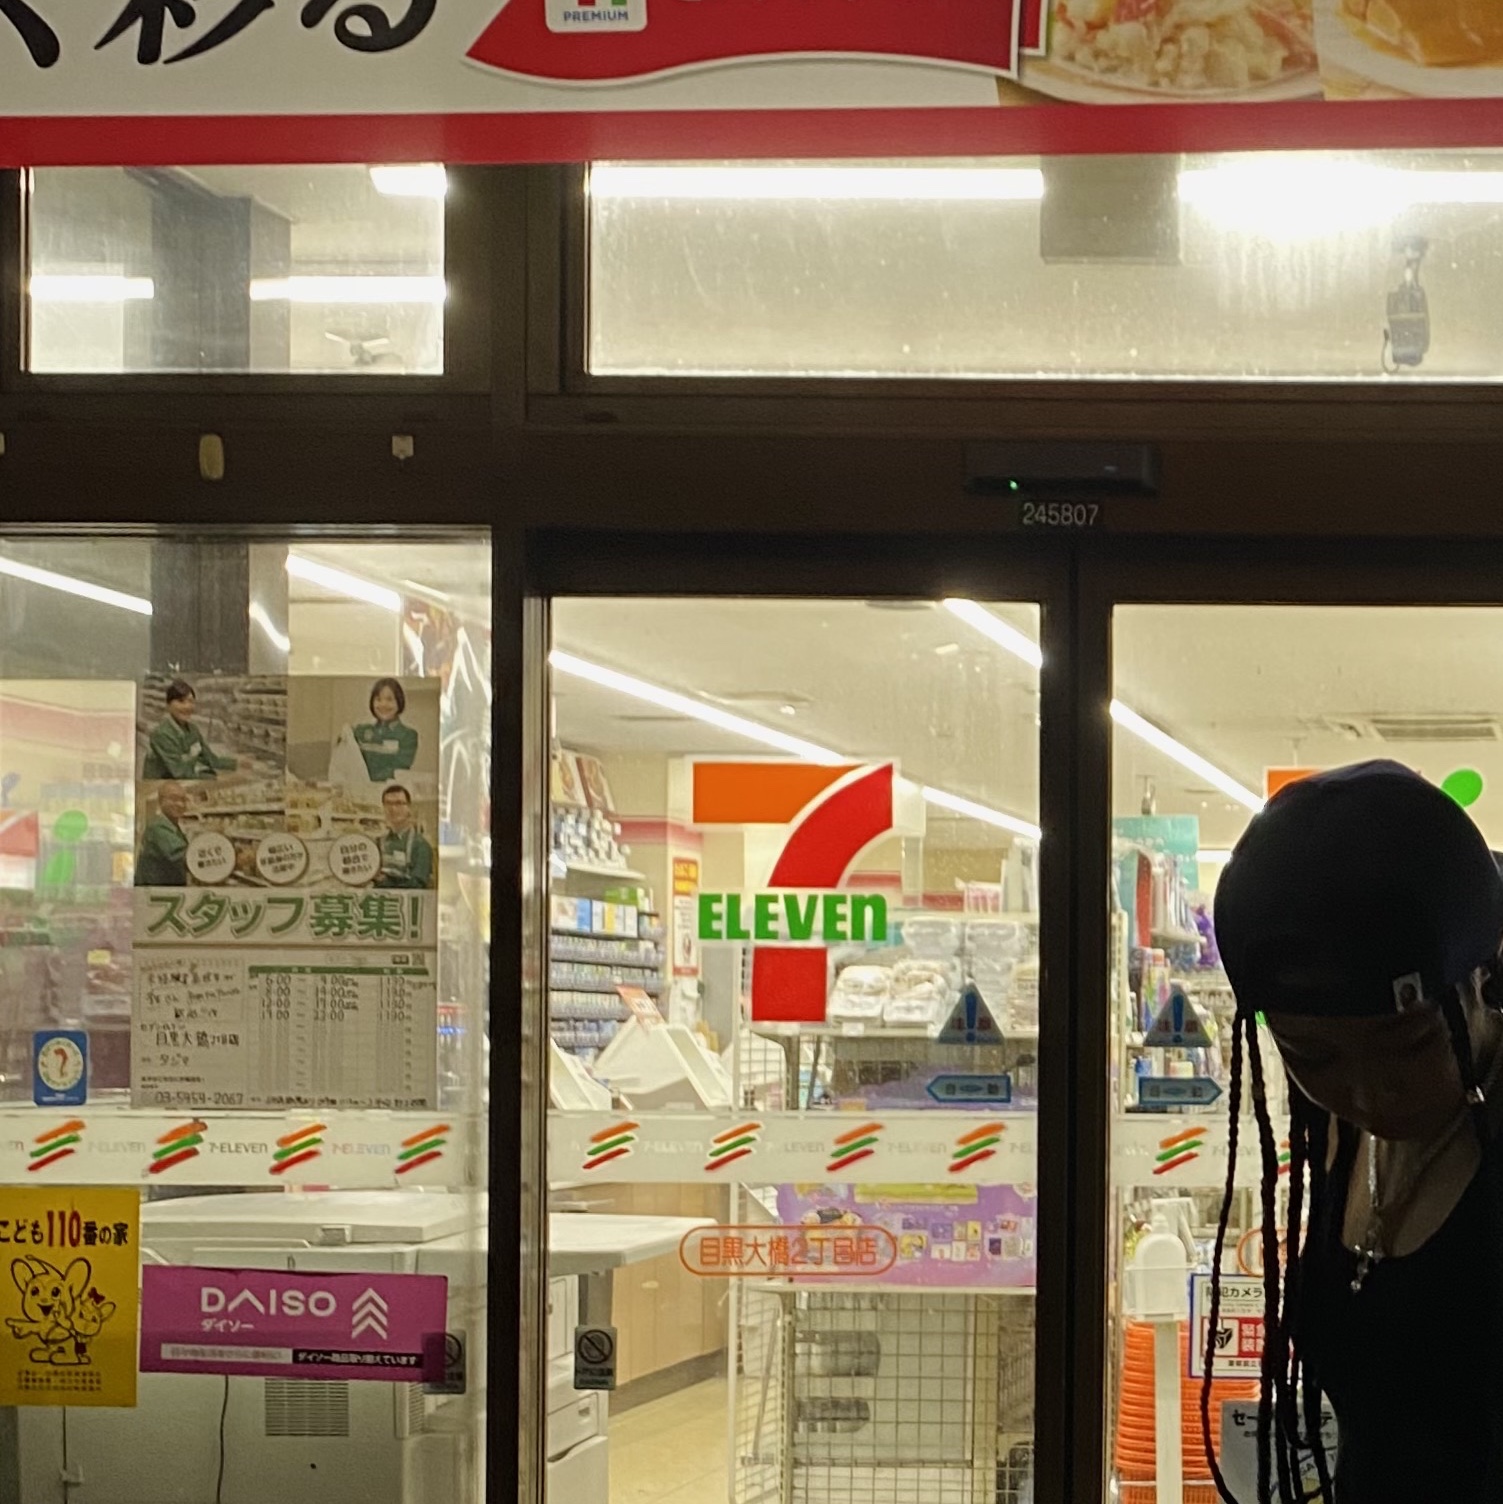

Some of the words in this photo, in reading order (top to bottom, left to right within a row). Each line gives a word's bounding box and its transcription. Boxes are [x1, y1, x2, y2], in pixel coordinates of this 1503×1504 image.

[564, 10, 629, 22] PREMIUM
[1023, 502, 1099, 526] 245807
[0, 1210, 129, 1247] こども110番の家
[701, 1236, 876, 1266] 目黒大橋2丁目店
[201, 1287, 337, 1317] DAISO
[201, 1318, 255, 1333] ダイソー
